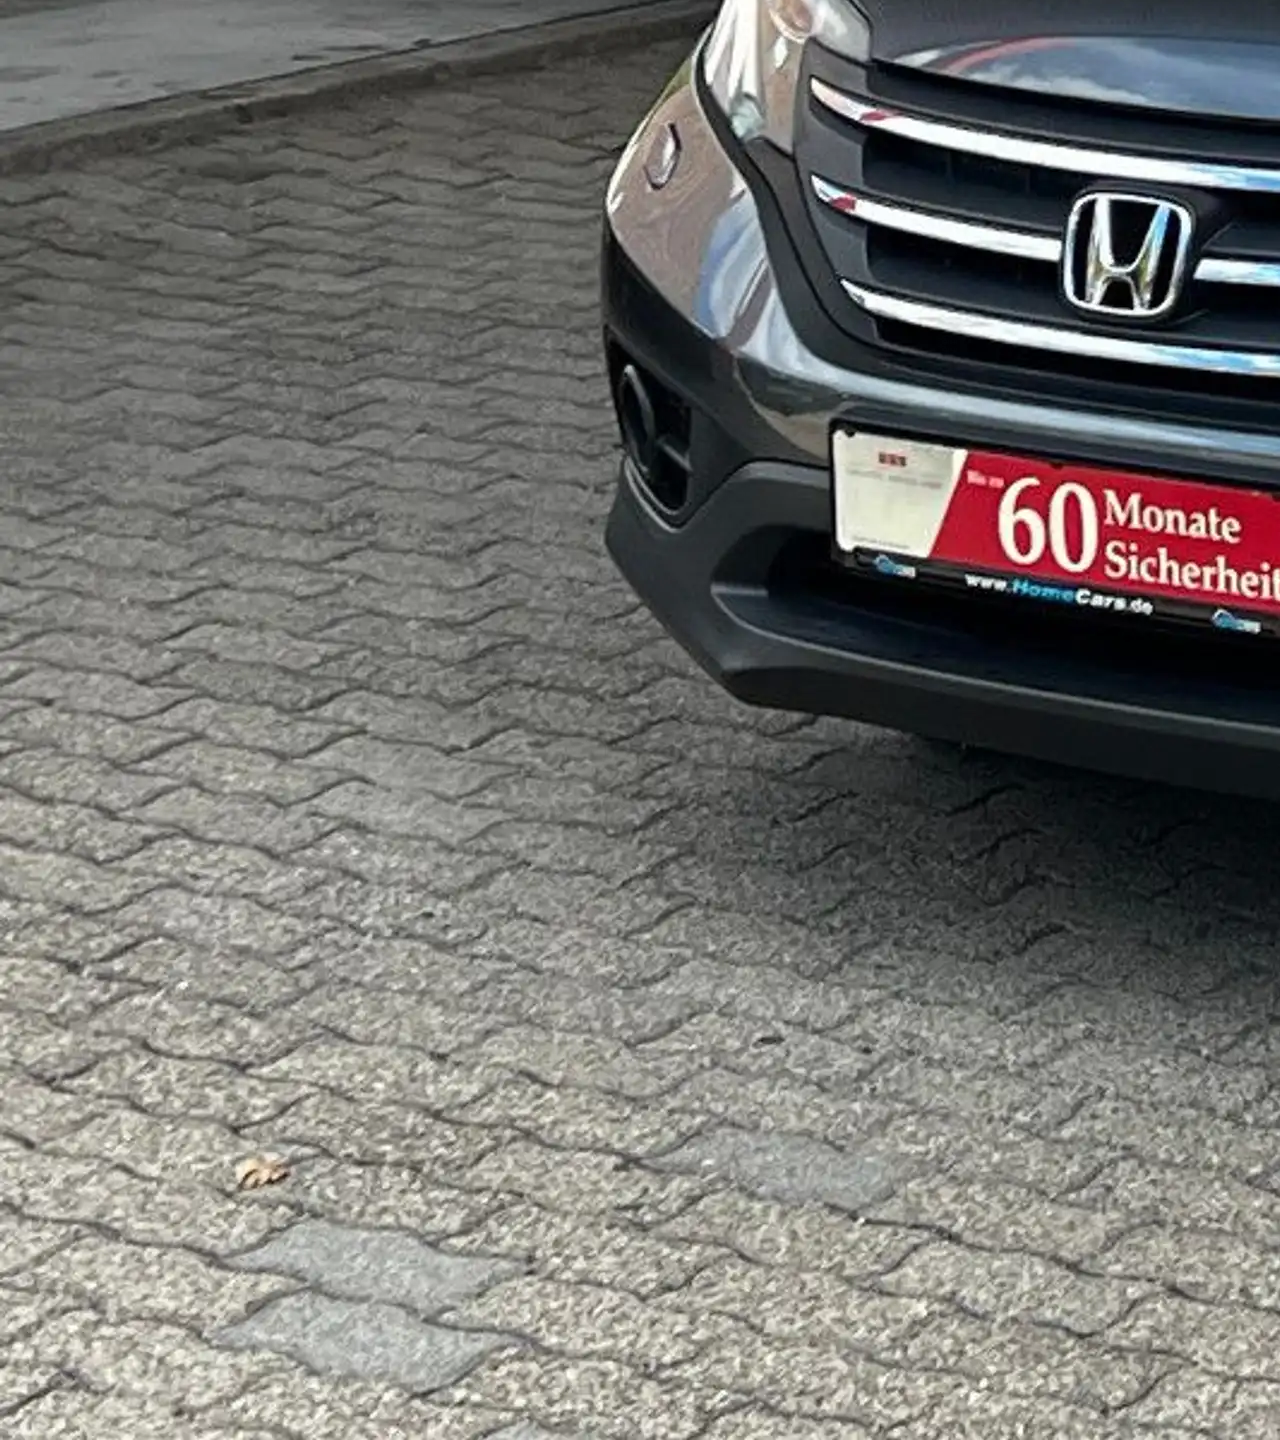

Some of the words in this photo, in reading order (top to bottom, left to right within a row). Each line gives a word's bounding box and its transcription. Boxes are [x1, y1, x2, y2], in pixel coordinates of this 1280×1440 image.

[998, 476, 1099, 573] 60
[1103, 488, 1242, 545] Monate
[964, 573, 1154, 616] www.HomeCars.de
